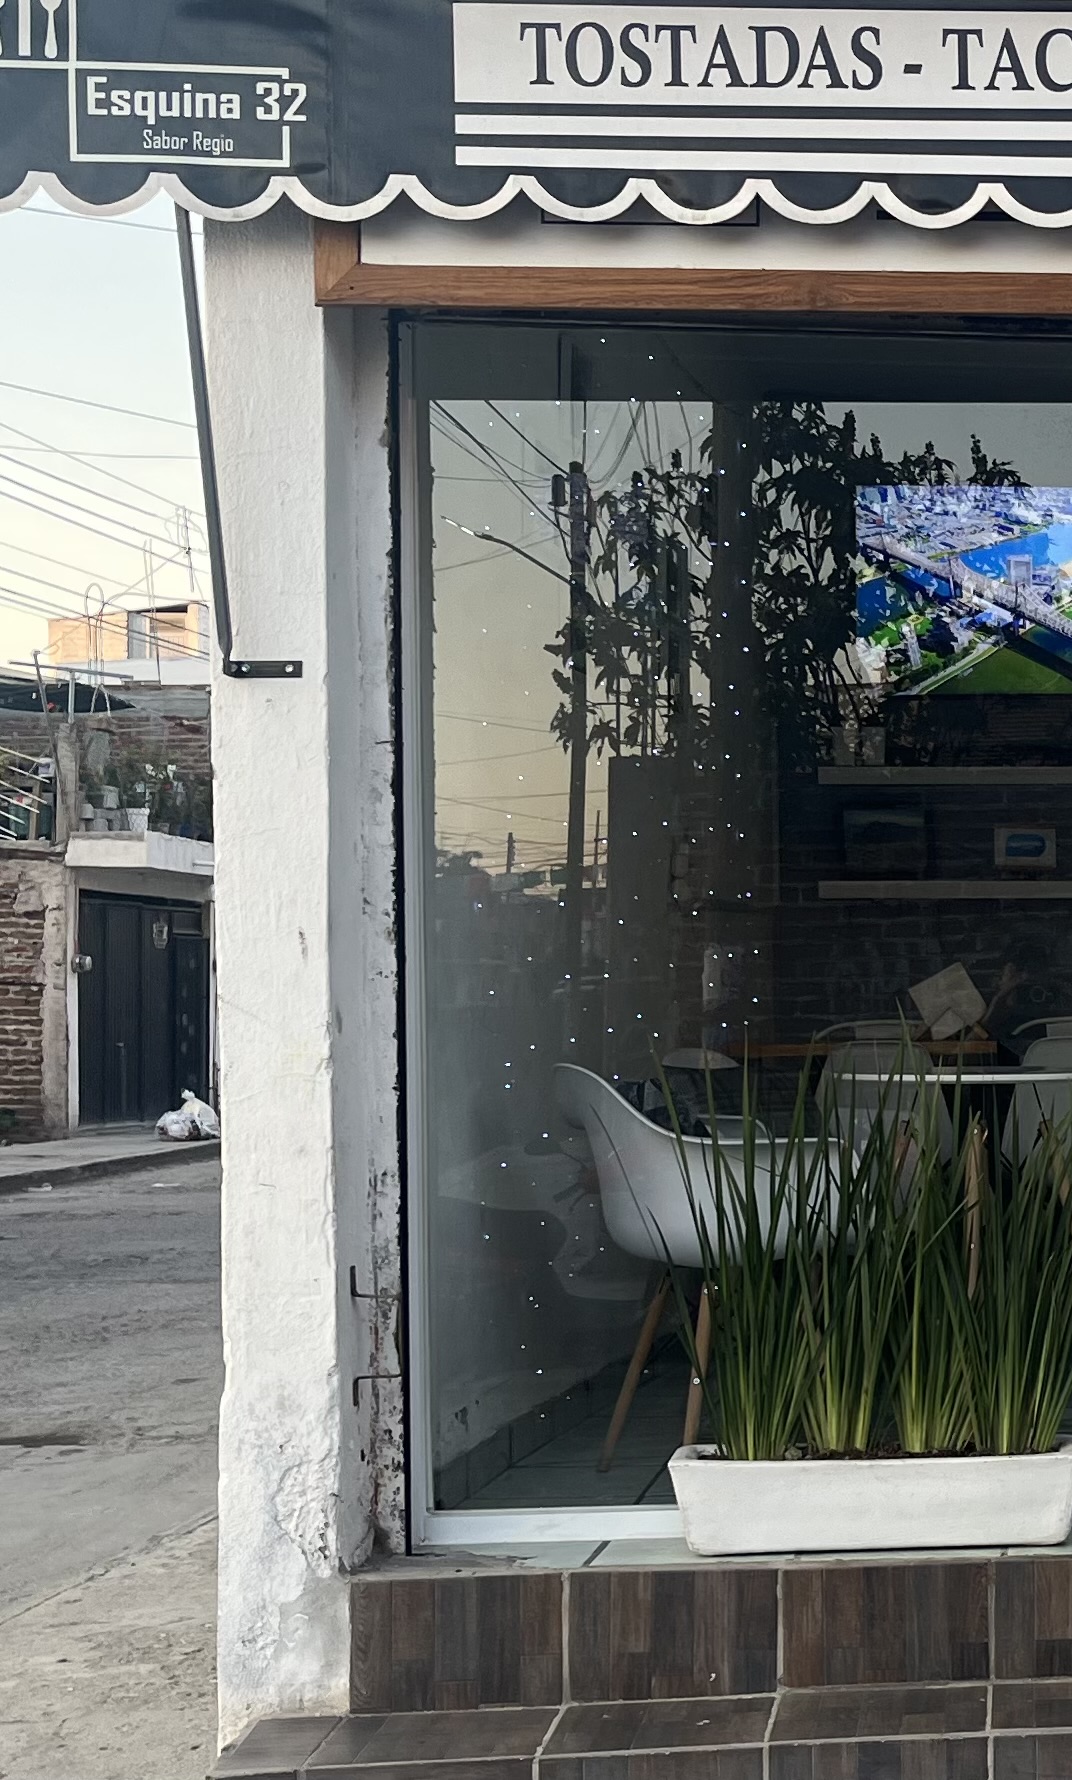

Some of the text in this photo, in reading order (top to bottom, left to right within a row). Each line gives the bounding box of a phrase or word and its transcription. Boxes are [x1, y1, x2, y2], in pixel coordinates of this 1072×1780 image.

[519, 21, 883, 91] TOSTADAS
[86, 75, 307, 125] Esquina 32
[142, 128, 234, 156] Sabor Regio
